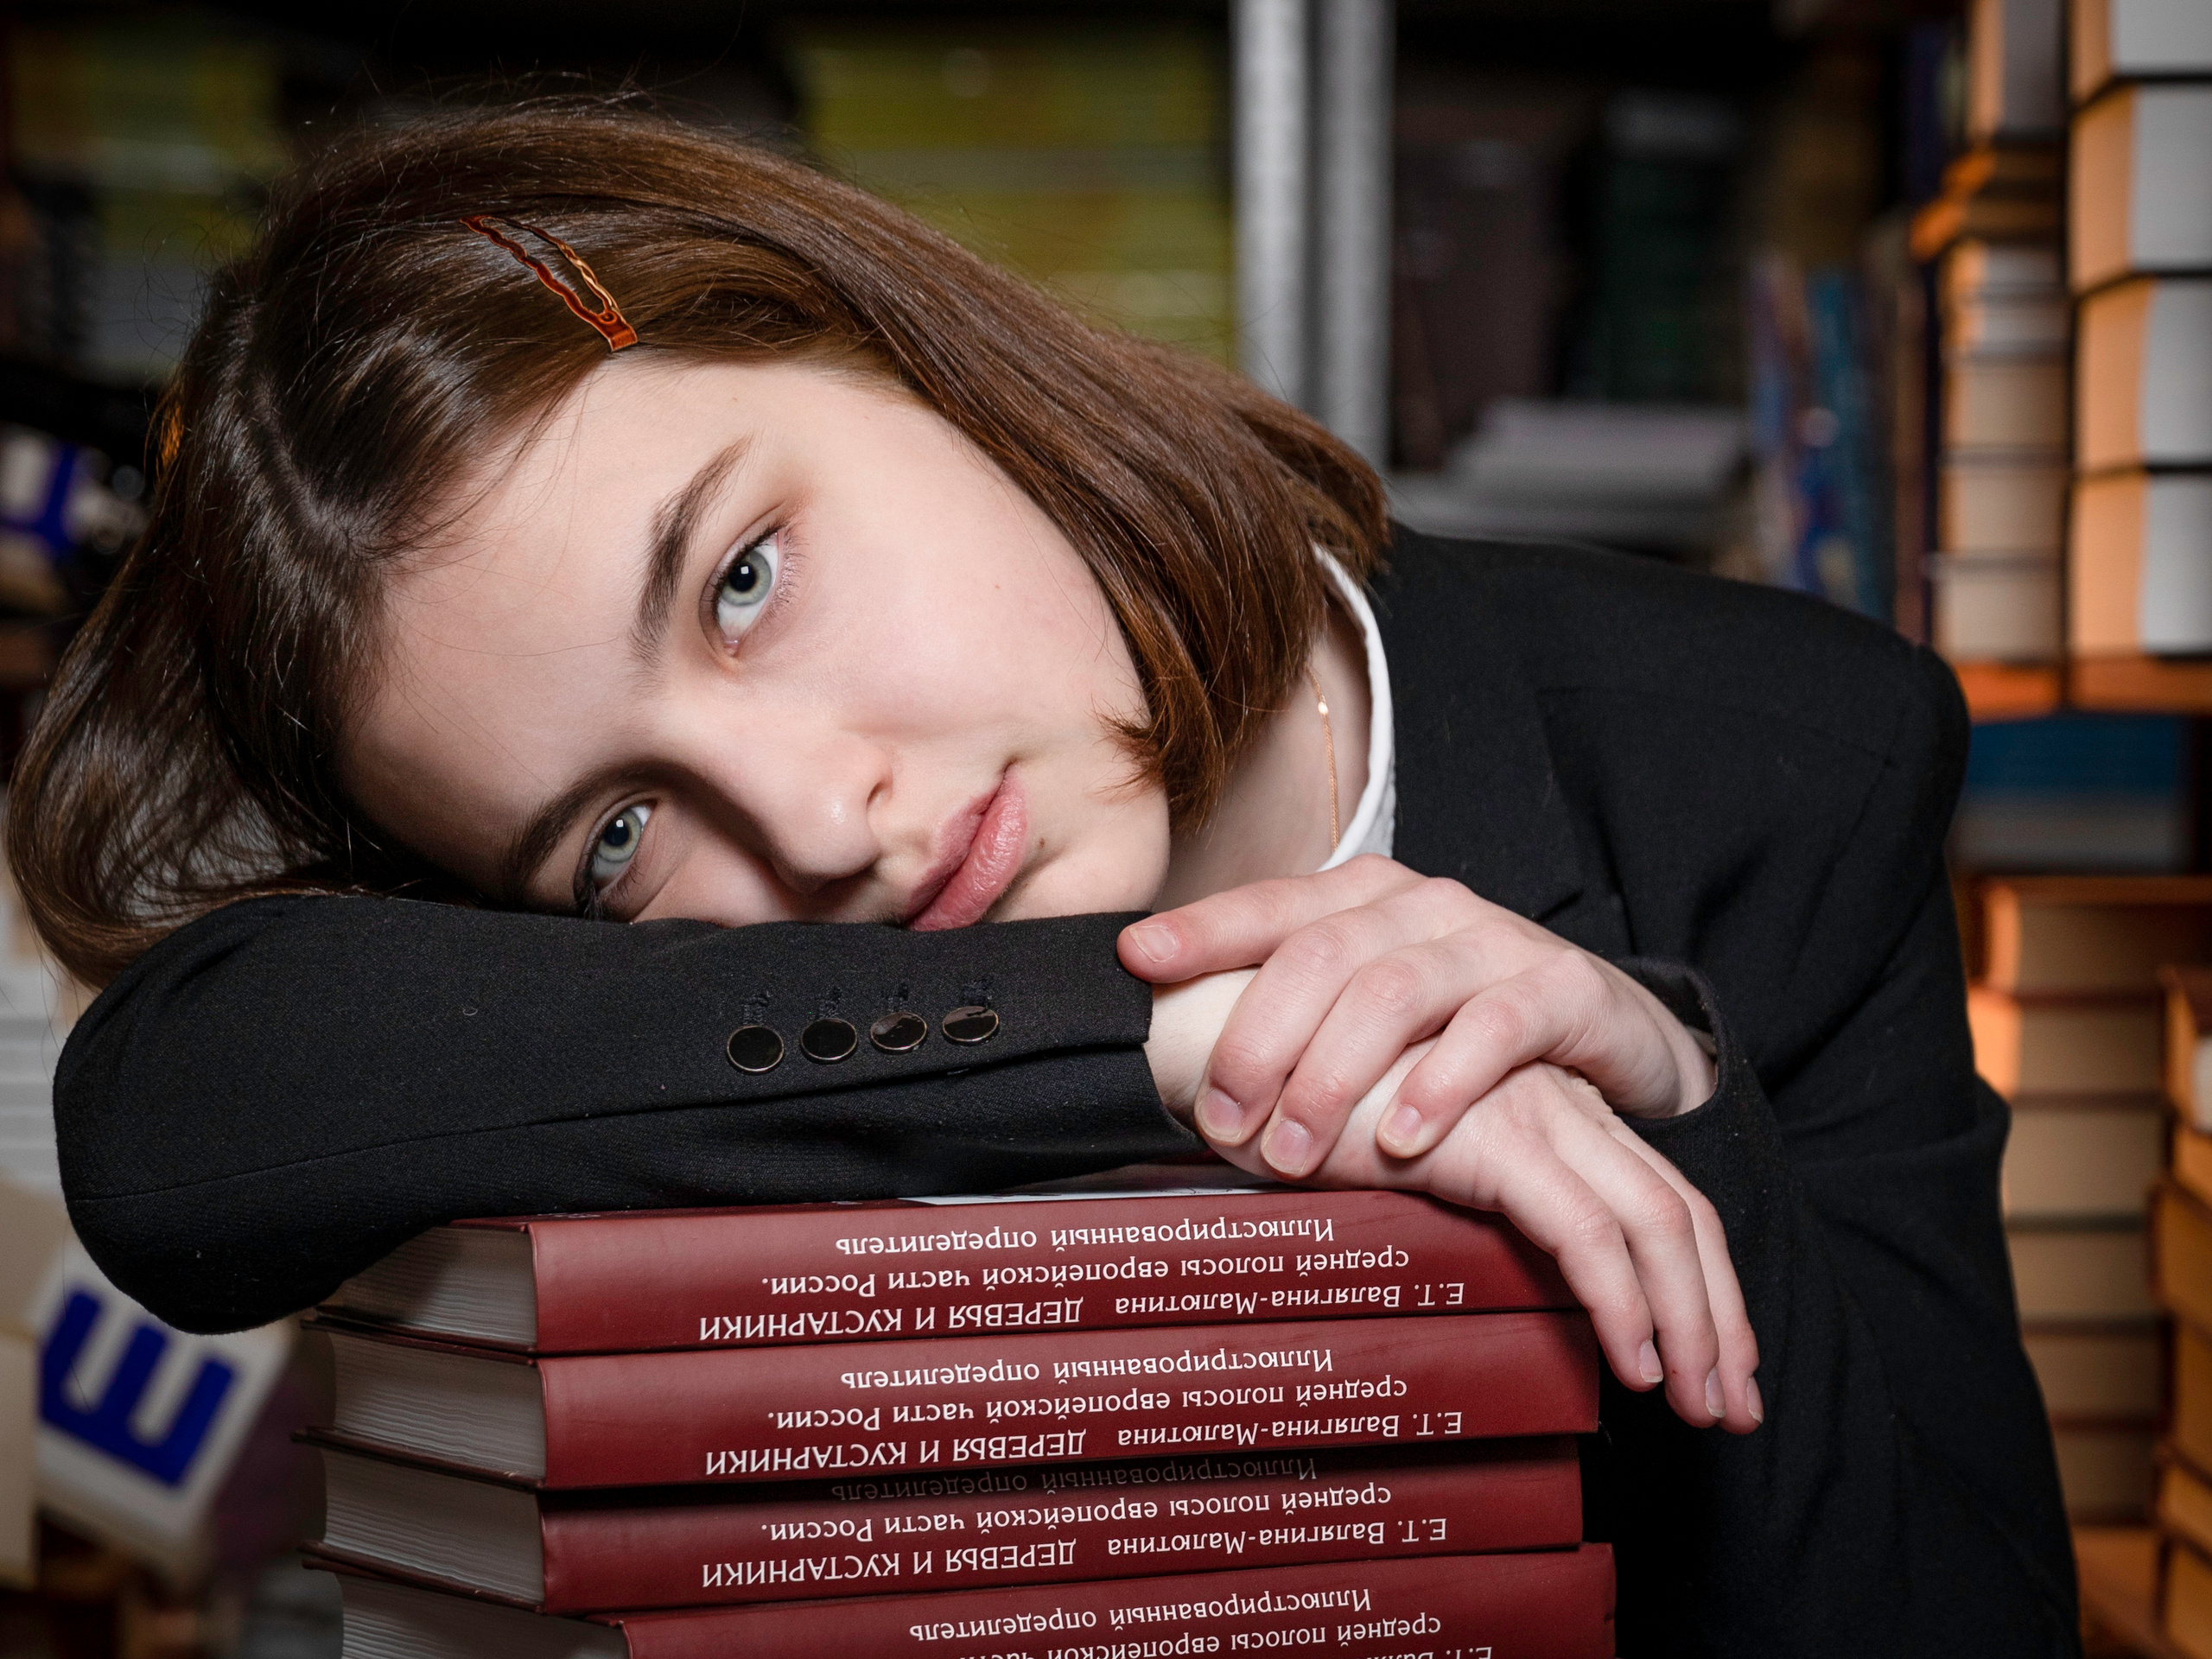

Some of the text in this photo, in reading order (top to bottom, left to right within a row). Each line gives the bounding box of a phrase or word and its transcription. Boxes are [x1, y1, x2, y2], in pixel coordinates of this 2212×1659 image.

[835, 1216, 1334, 1255] Иллюстрированный определитель
[761, 1244, 1409, 1298] средней полосы европейской части России.
[948, 1295, 1084, 1329] ДЕРЕВЬЯ
[1115, 1285, 1402, 1315] Валягина-Малютина
[699, 1307, 903, 1341] КУСТАРНИКИ
[914, 1306, 936, 1331] И
[840, 1347, 1333, 1389] Иллюстрированный определитель
[767, 1374, 1408, 1432] средней полосы европейской части России.
[952, 1427, 1087, 1462] ДЕРЕВЬЯ
[1117, 1414, 1400, 1446] Валягина-Малютина
[705, 1441, 907, 1476] КУСТАРНИКИ
[918, 1440, 940, 1464] И
[831, 1458, 1318, 1501] Иллюстрированный определитель
[760, 1481, 1392, 1542] средней полосы европейской части России.
[944, 1537, 1077, 1573] ДЕРЕВЬЯ
[1107, 1522, 1385, 1556] Валягина-Малютина
[702, 1552, 900, 1588] КУСТАРНИКИ
[912, 1550, 933, 1575] И
[909, 1588, 1372, 1642] Иллюстрированный определитель
[1337, 1611, 1441, 1648] средней
[1230, 1626, 1326, 1650] полосы
